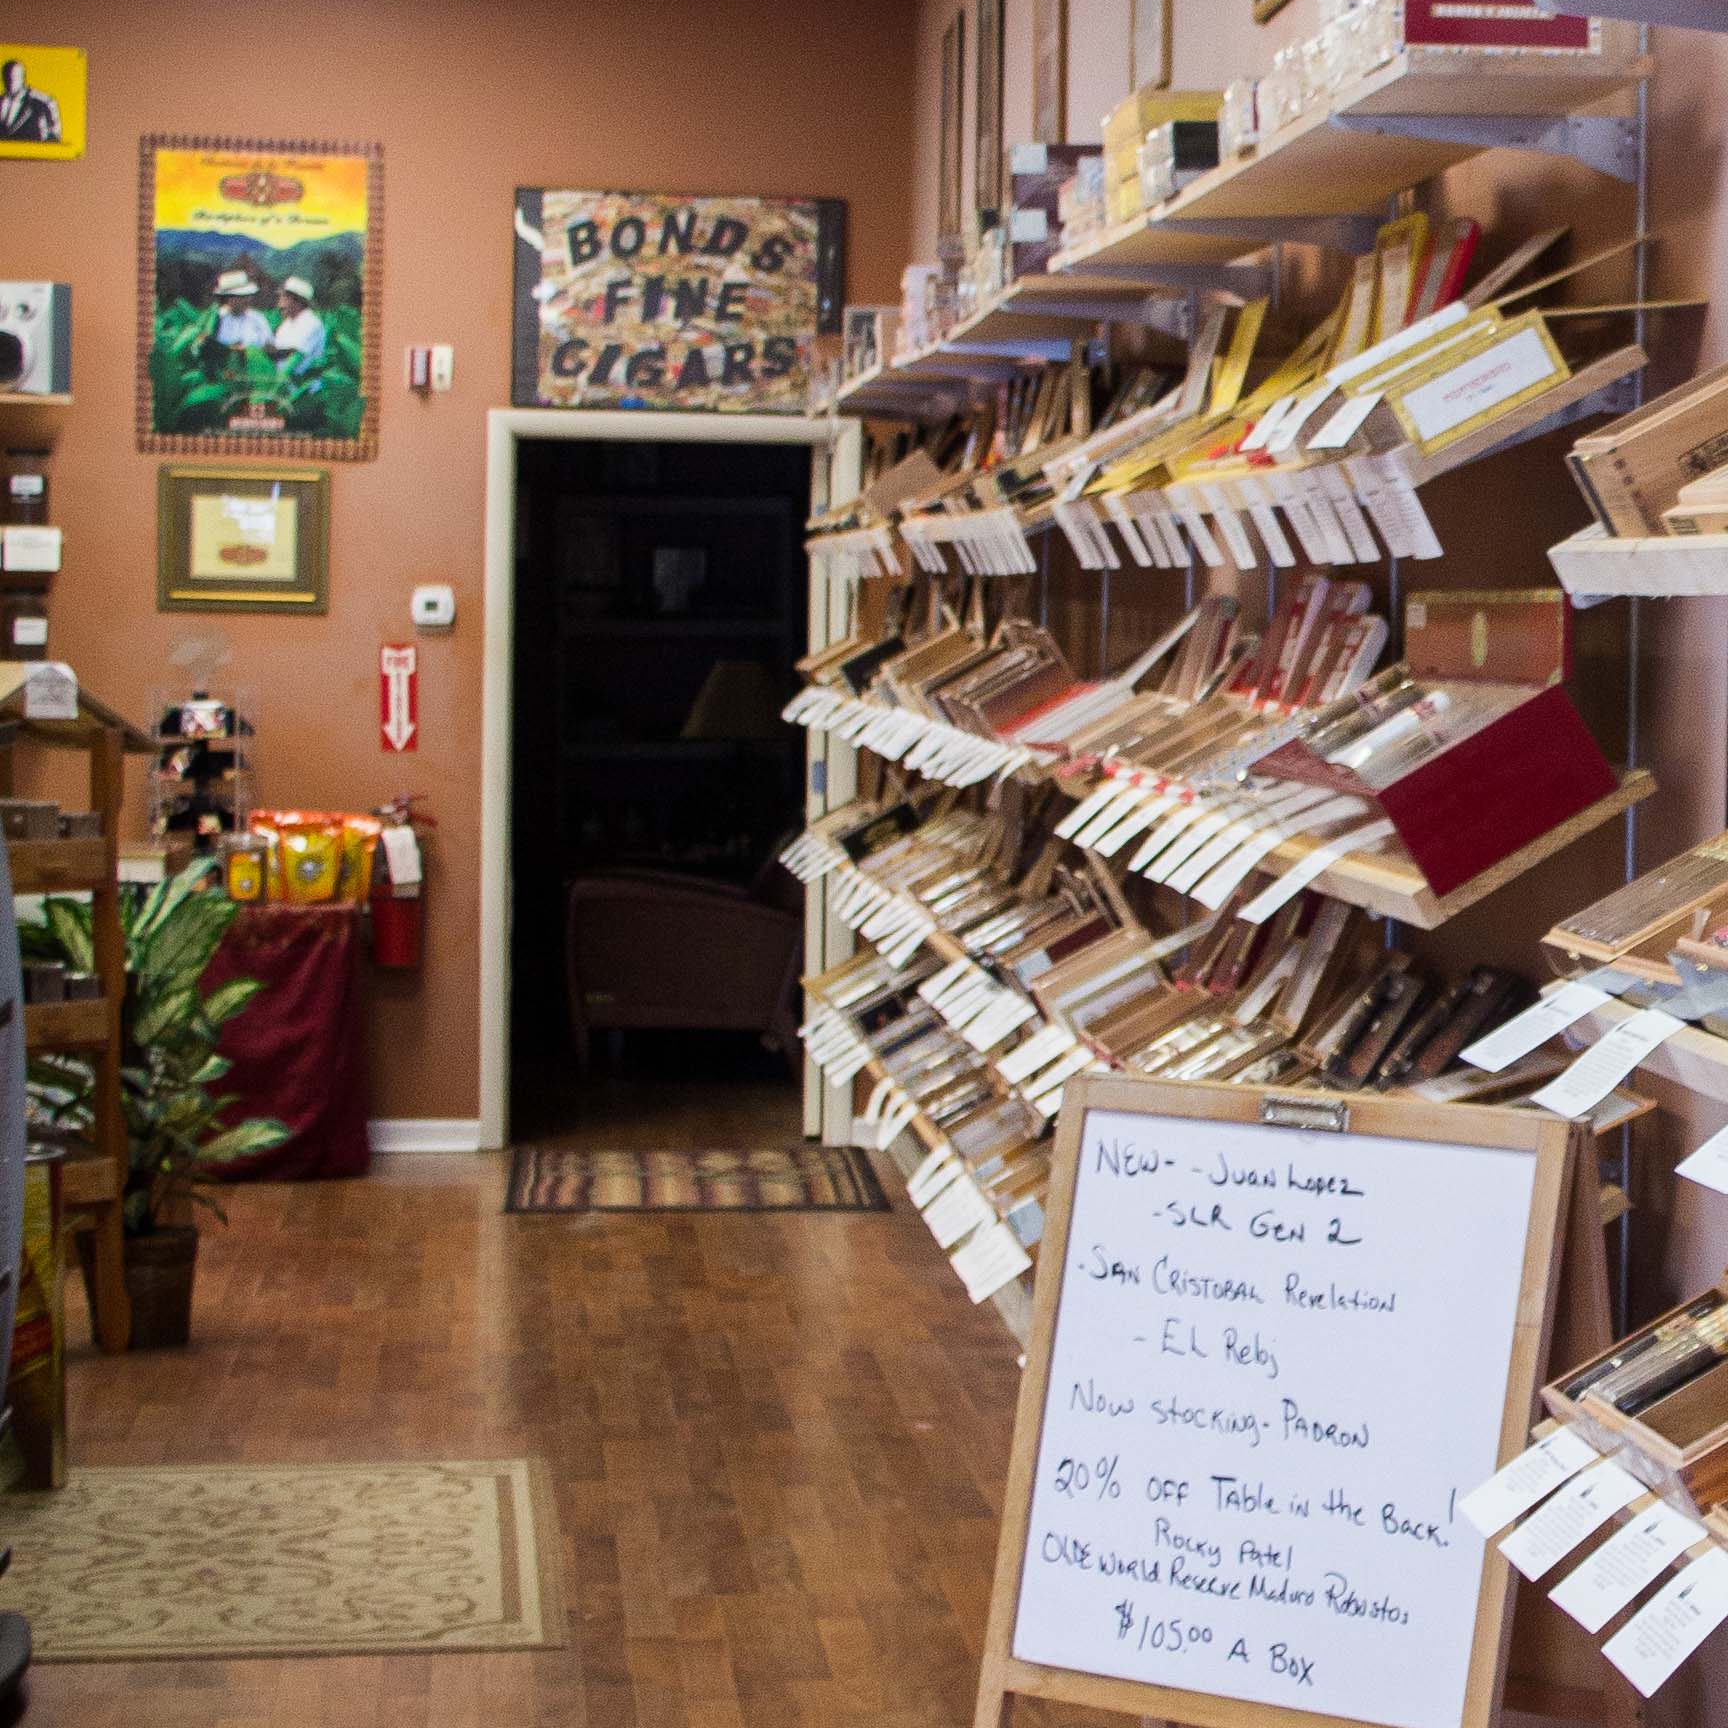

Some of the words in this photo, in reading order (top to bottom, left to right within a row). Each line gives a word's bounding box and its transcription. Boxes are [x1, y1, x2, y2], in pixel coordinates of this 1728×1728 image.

[567, 209, 796, 271] BONDS
[603, 272, 751, 325] FINE
[551, 335, 798, 390] CIGARS
[1288, 1163, 1365, 1197] Lopez
[1326, 1217, 1363, 1244] 2
[1284, 1271, 1396, 1314] Revelation
[1069, 1381, 1136, 1418] Now
[1281, 1397, 1370, 1449] PADRON
[1053, 1454, 1122, 1501] 20%
[1321, 1487, 1366, 1528] the
[1154, 1517, 1222, 1569] Rocky
[1238, 1539, 1294, 1571] Patel
[1249, 1576, 1315, 1609] Maduro
[1226, 1637, 1251, 1665] A
